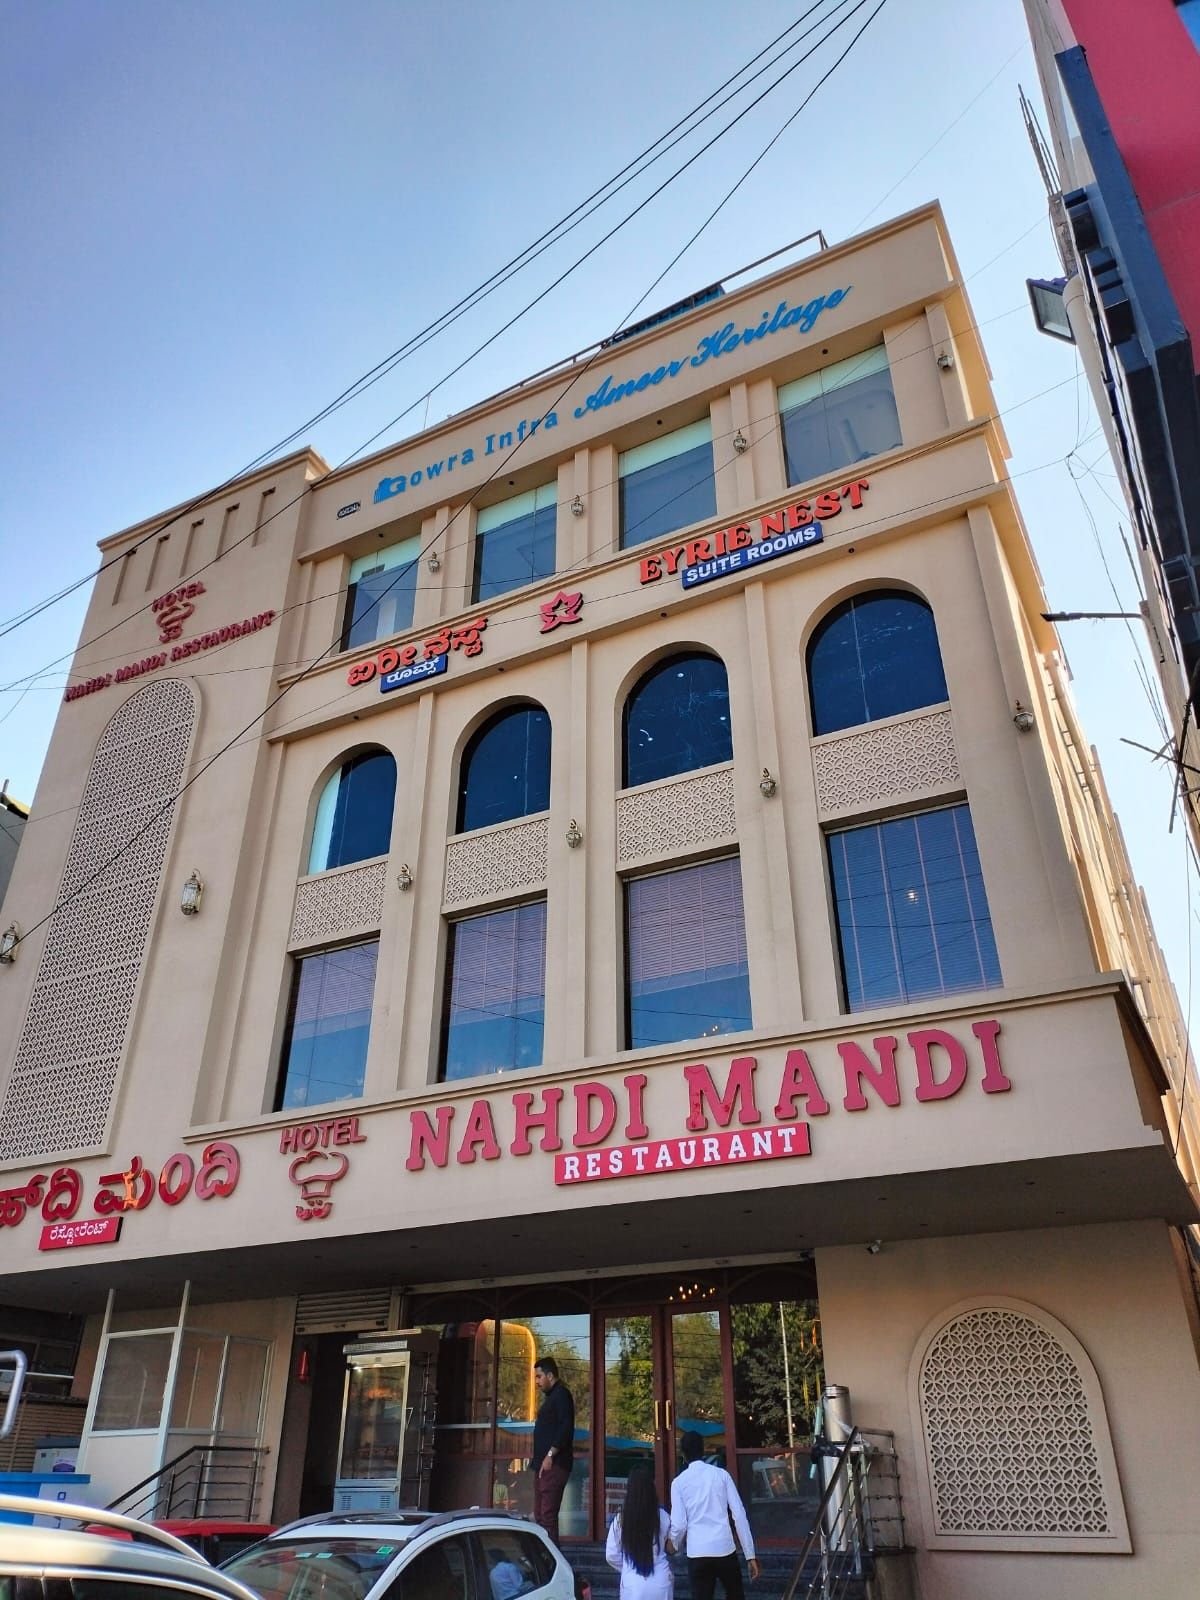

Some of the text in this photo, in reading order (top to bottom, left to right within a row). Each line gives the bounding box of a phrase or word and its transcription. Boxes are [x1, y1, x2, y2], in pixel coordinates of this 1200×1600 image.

[374, 286, 854, 504] Gowra Infra Ameer Heritage
[640, 479, 869, 585] EYRIE NEST
[686, 526, 816, 583] SUITE ROOMS
[151, 581, 206, 613] HOTEL
[65, 609, 276, 702] NAHDI MANDI RESTAURANT
[347, 645, 417, 686] ಐರೀ
[405, 1019, 1011, 1171] NAHDI MANDI
[280, 1117, 367, 1154] HOTEL
[563, 1127, 796, 1180] RESTAURANT
[93, 1142, 240, 1214] ಮಂದಿ
